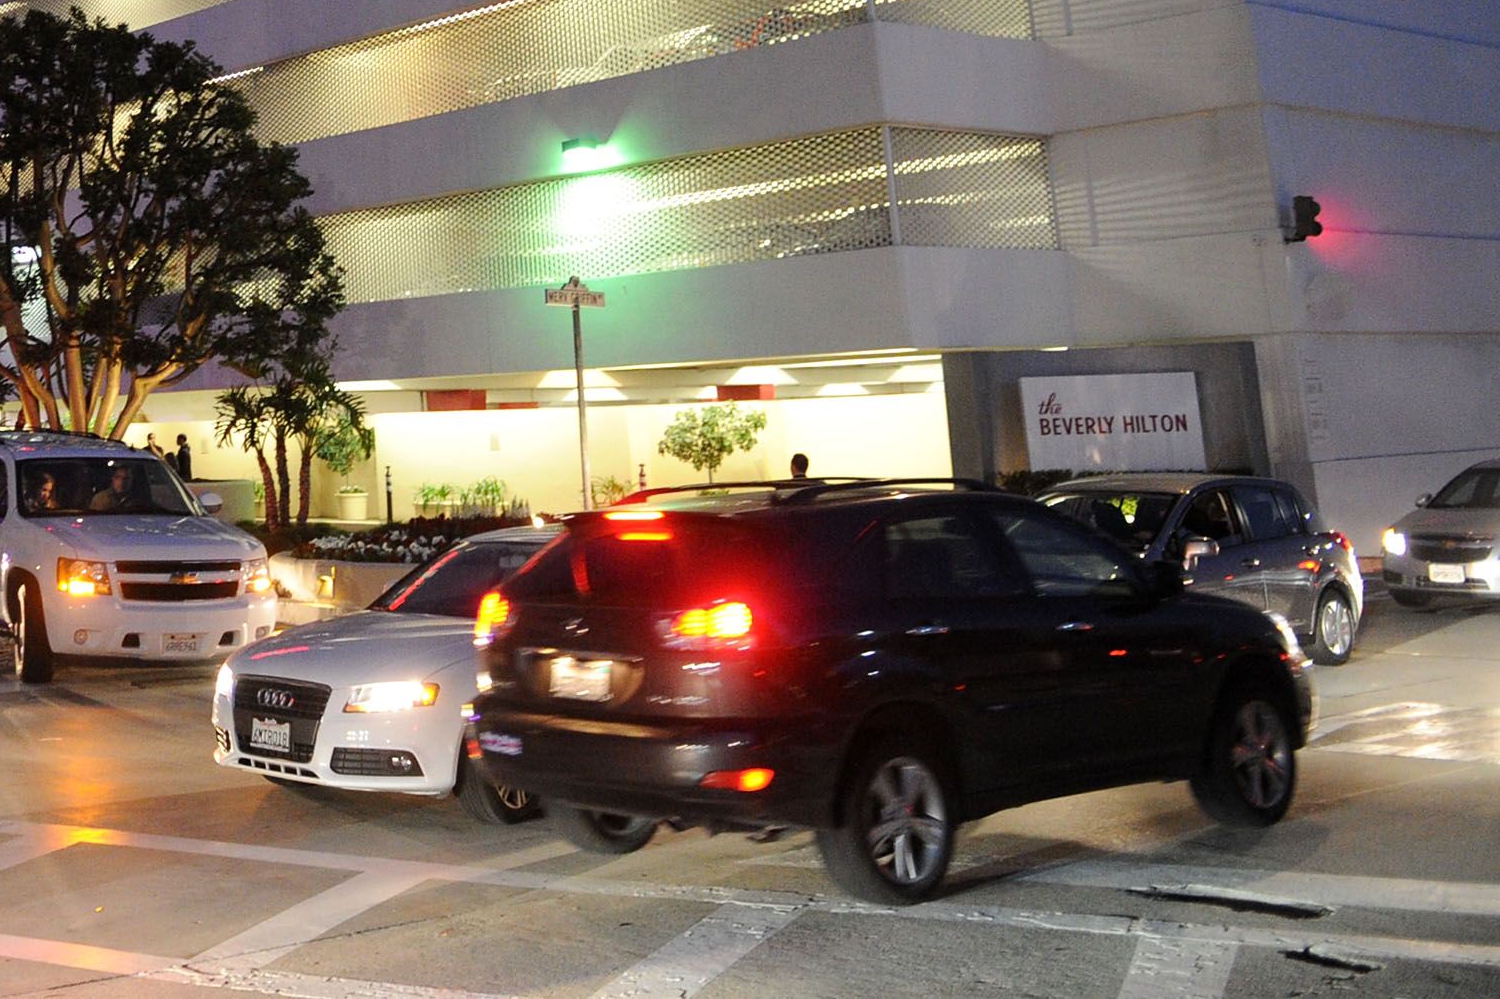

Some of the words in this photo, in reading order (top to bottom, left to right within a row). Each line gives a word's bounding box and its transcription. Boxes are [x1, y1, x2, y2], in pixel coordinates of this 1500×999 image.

[1038, 392, 1062, 415] the
[1040, 416, 1114, 436] BEVERLY
[1123, 414, 1188, 433] HILTON
